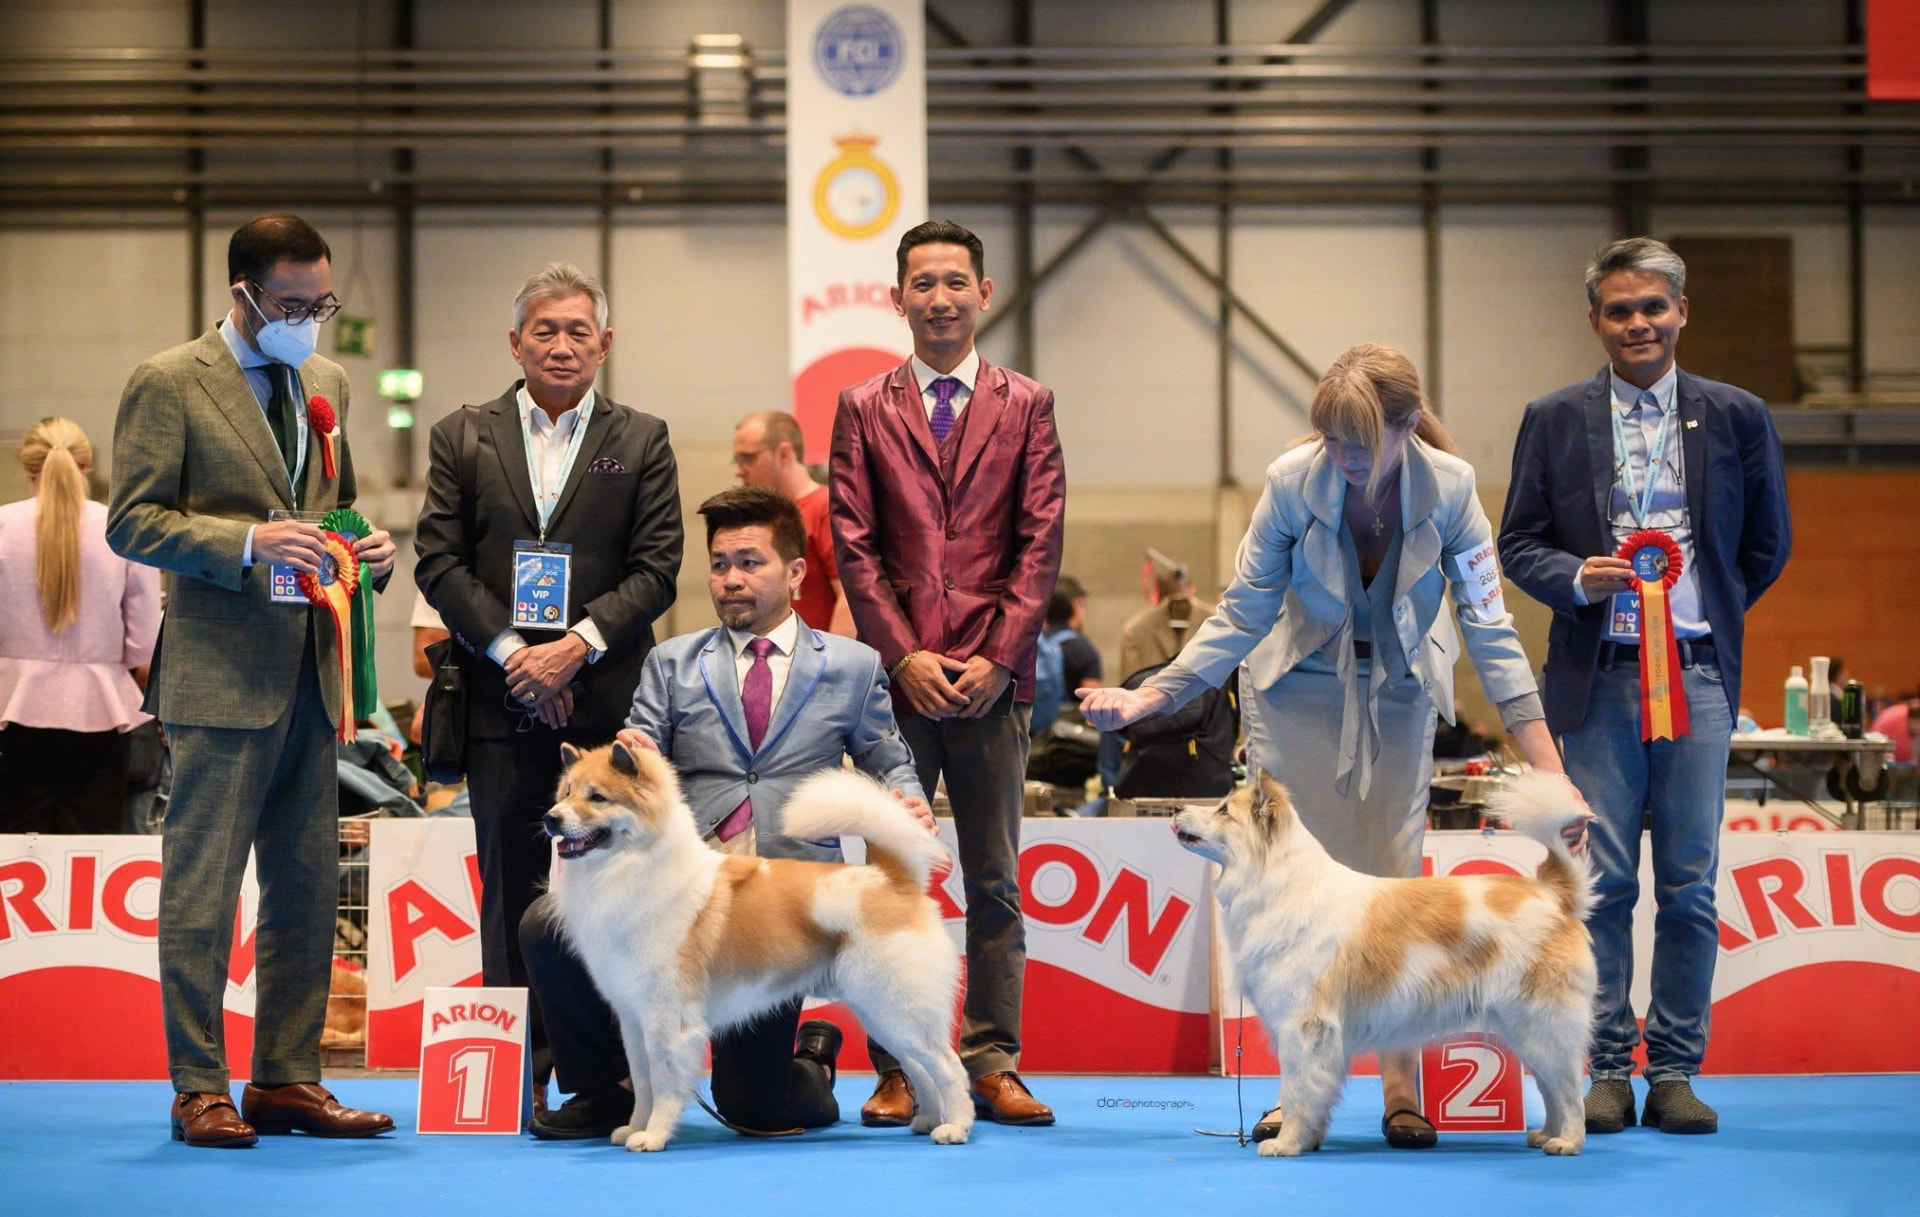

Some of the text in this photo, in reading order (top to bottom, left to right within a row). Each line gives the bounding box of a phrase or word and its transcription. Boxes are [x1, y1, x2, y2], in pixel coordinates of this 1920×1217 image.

[802, 281, 907, 325] ARIO
[532, 590, 549, 599] VIP
[431, 1002, 518, 1034] ARION
[450, 1047, 494, 1123] 1
[1441, 1042, 1504, 1121] 2
